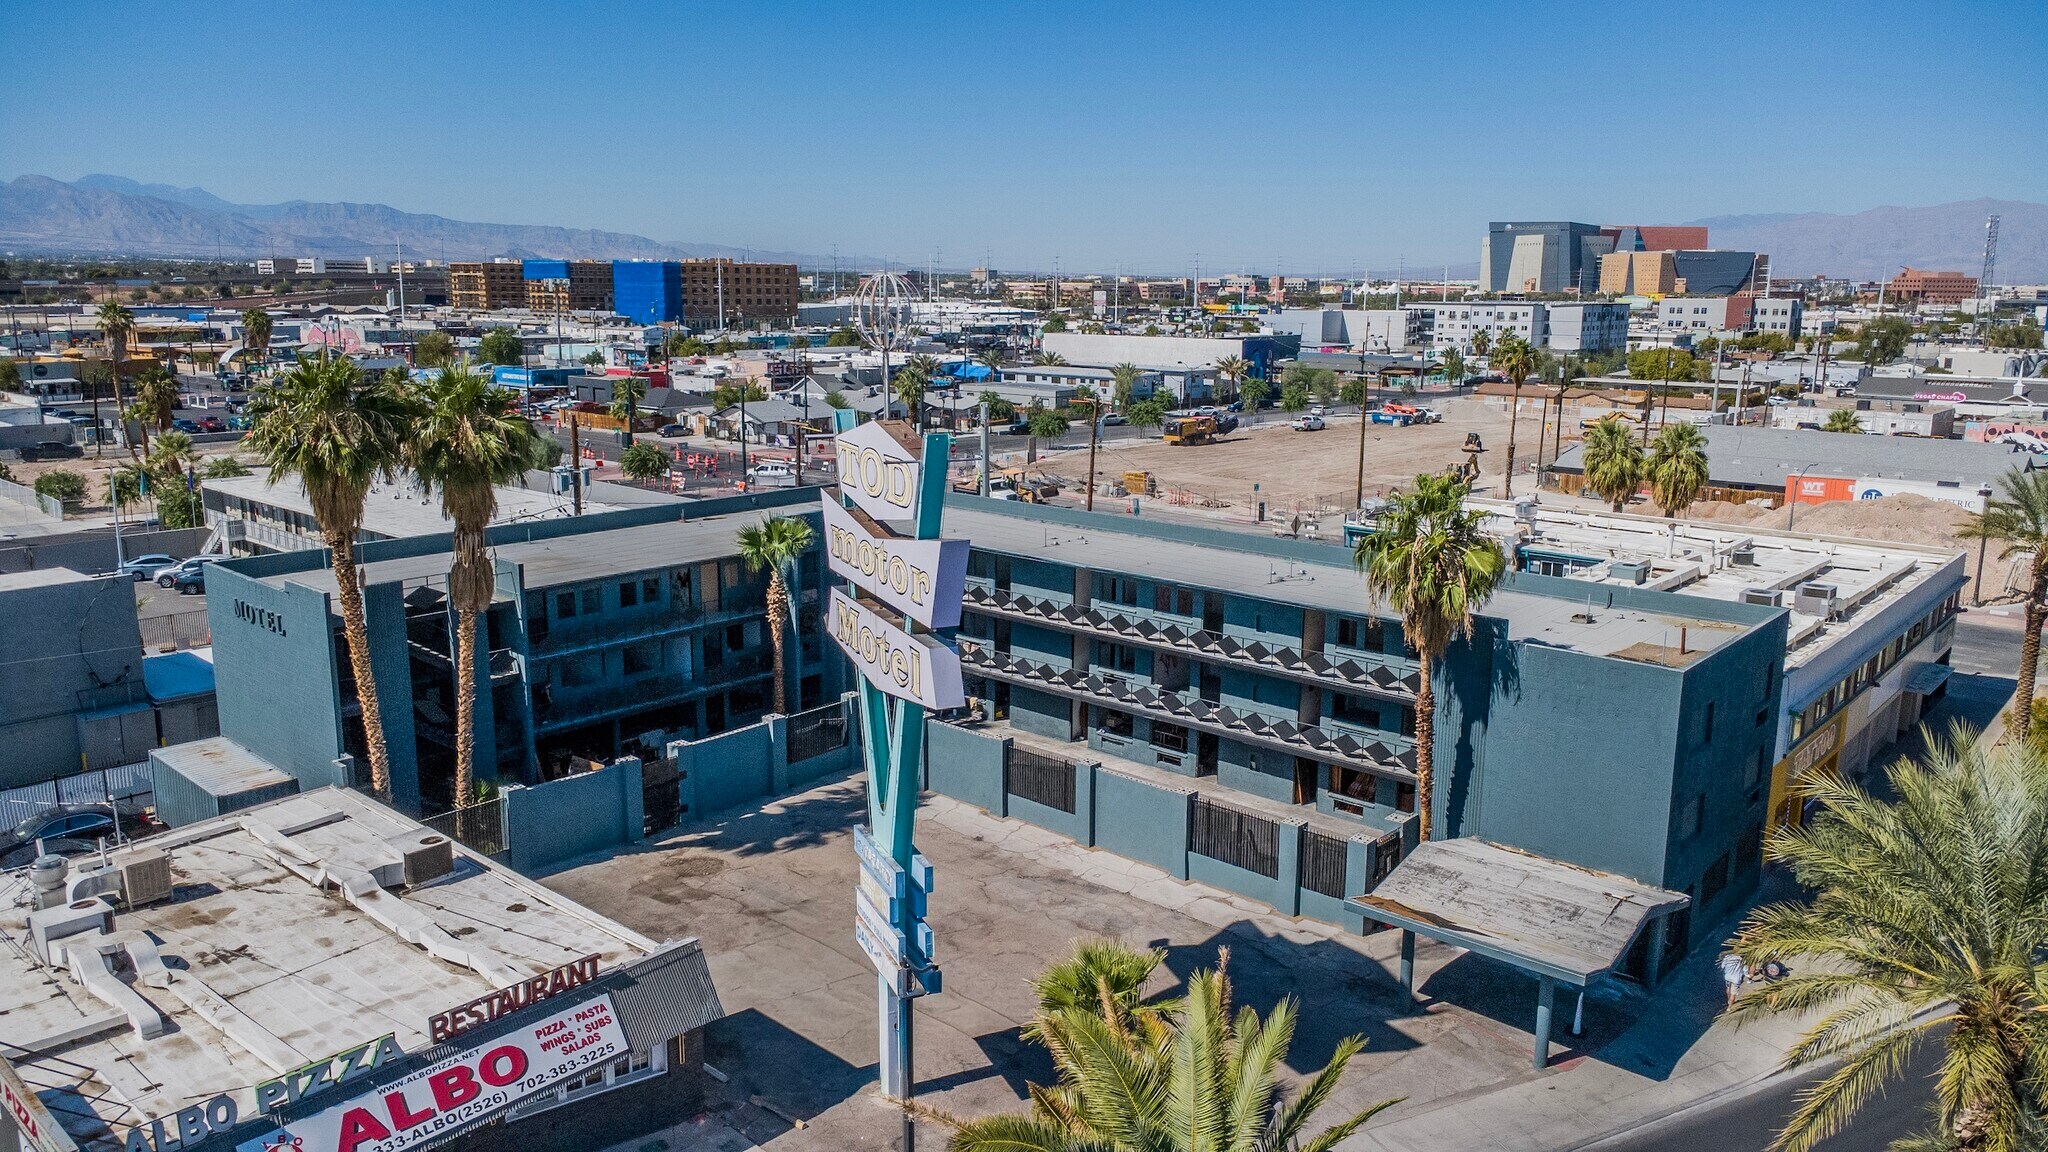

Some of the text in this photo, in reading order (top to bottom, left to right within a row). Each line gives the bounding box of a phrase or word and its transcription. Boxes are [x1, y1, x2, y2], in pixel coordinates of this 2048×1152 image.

[838, 440, 913, 508] TOD
[1803, 482, 1824, 490] WT
[831, 524, 930, 606] motor
[233, 598, 286, 637] MOTEL
[836, 599, 923, 700] Motel
[430, 953, 601, 1044] RESTAURANT
[535, 1003, 608, 1040] PIZZA PASTA
[540, 1015, 612, 1052] WINGS SUBS
[561, 1033, 602, 1056] SALADS
[125, 1034, 407, 1152] ALBO PIZZA
[377, 1048, 480, 1095] WWW.ALBOPIZZA.NET
[517, 1042, 616, 1093] 702-383-3225
[5, 1084, 40, 1144] PIZZA
[338, 1044, 530, 1152] ALBO
